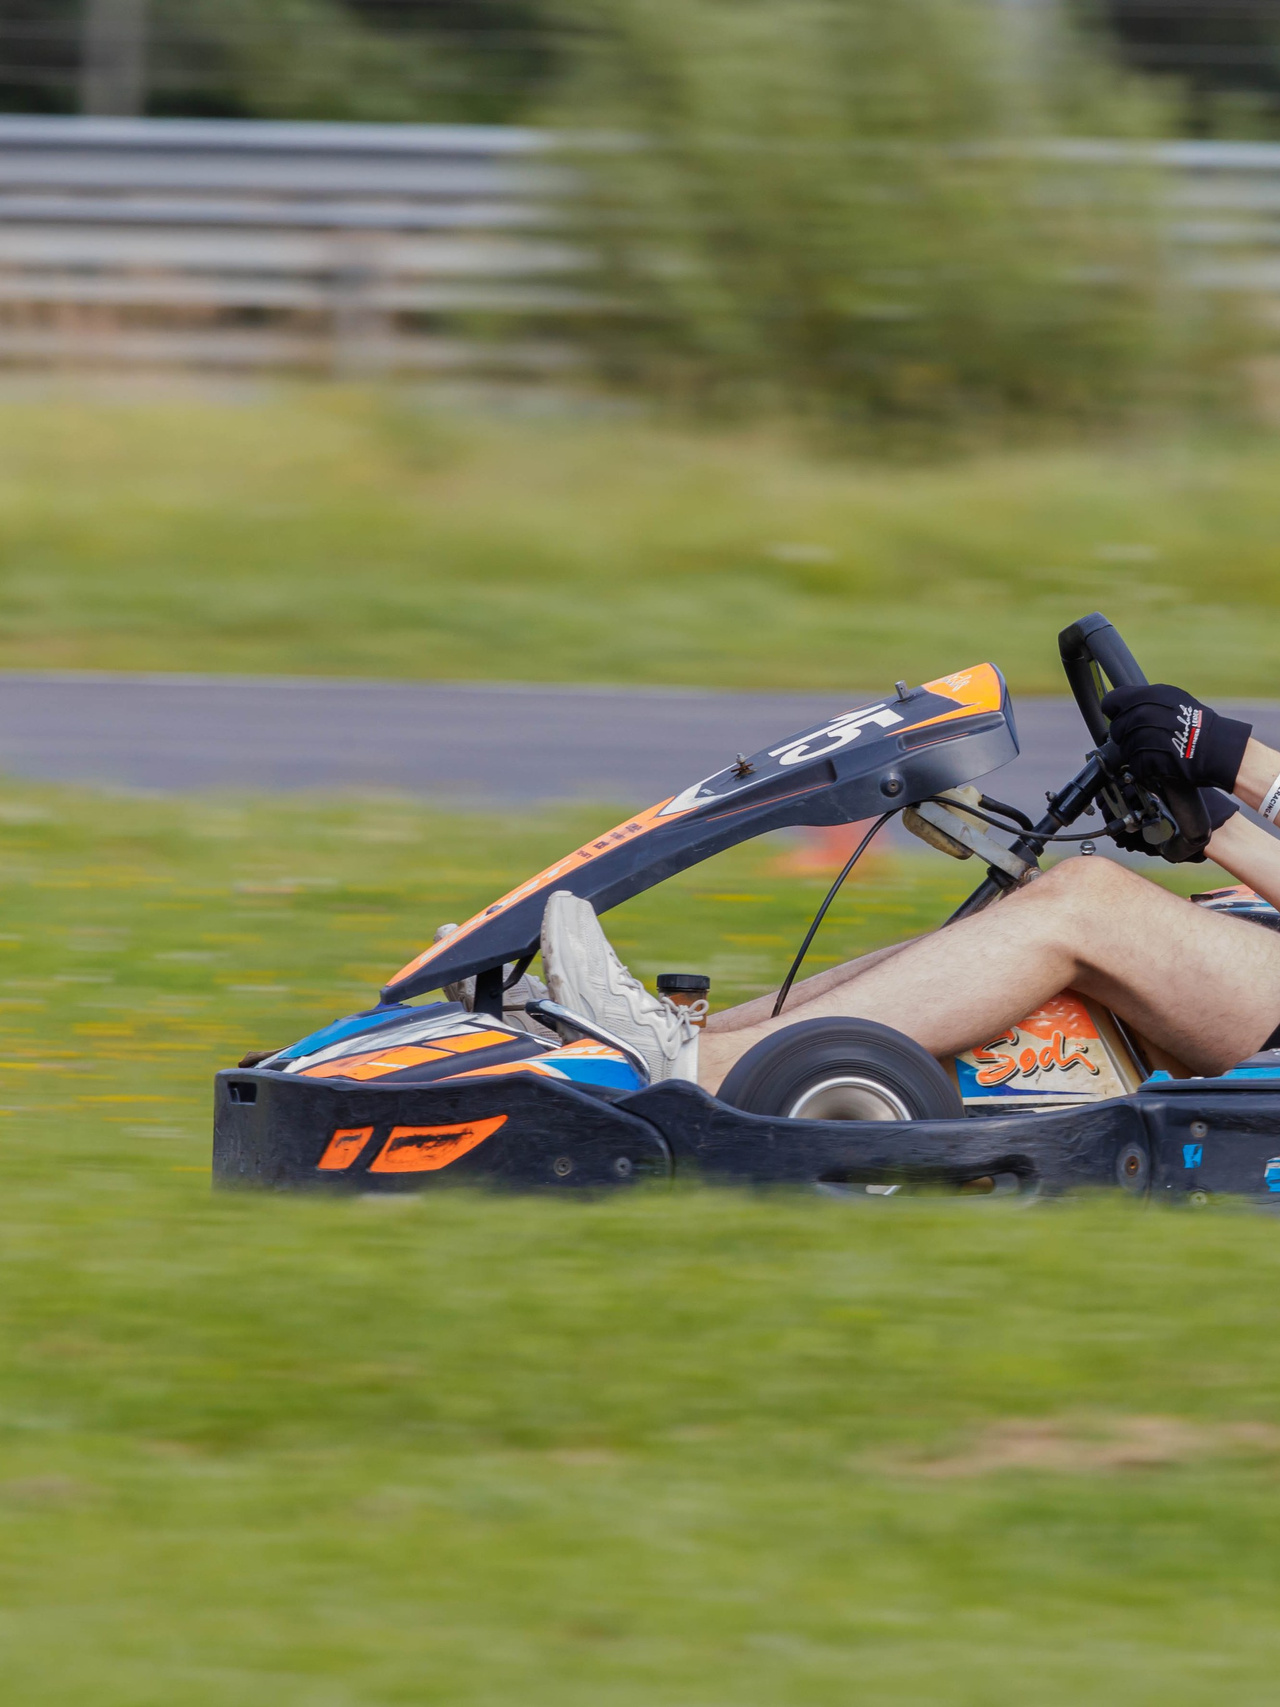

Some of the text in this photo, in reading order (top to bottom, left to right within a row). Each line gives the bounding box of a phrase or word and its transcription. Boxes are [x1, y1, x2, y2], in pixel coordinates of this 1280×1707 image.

[767, 703, 905, 766] 15
[1171, 704, 1193, 758] Absolute
[971, 1027, 1100, 1087] Sodi
